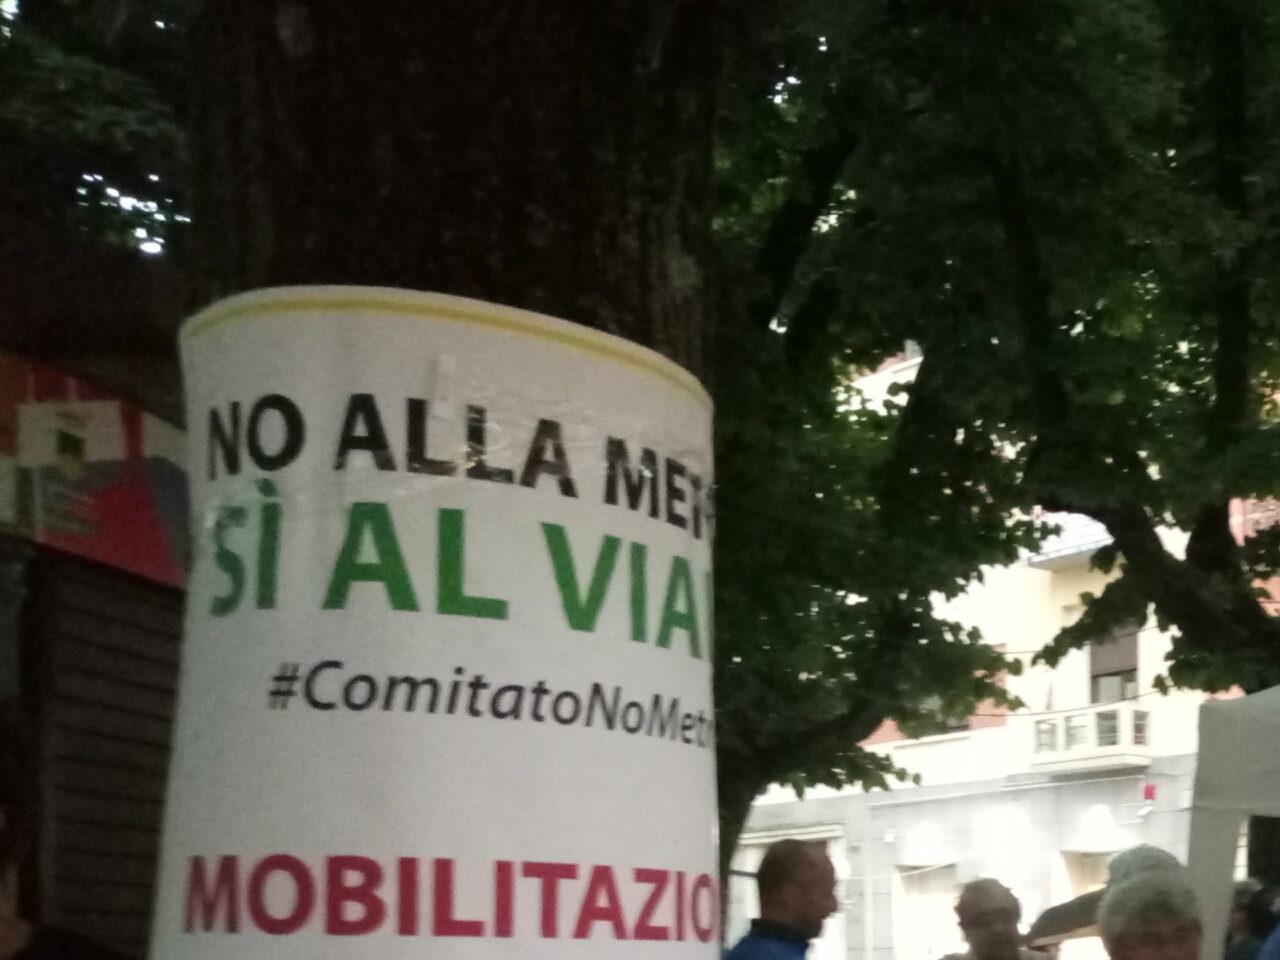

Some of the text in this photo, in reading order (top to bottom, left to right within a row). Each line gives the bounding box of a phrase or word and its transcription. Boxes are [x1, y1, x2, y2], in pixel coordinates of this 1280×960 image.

[208, 393, 716, 540] NO ALLA MET
[209, 478, 714, 661] SÌ AL VIA
[183, 853, 722, 943] MOBILITAZIO
